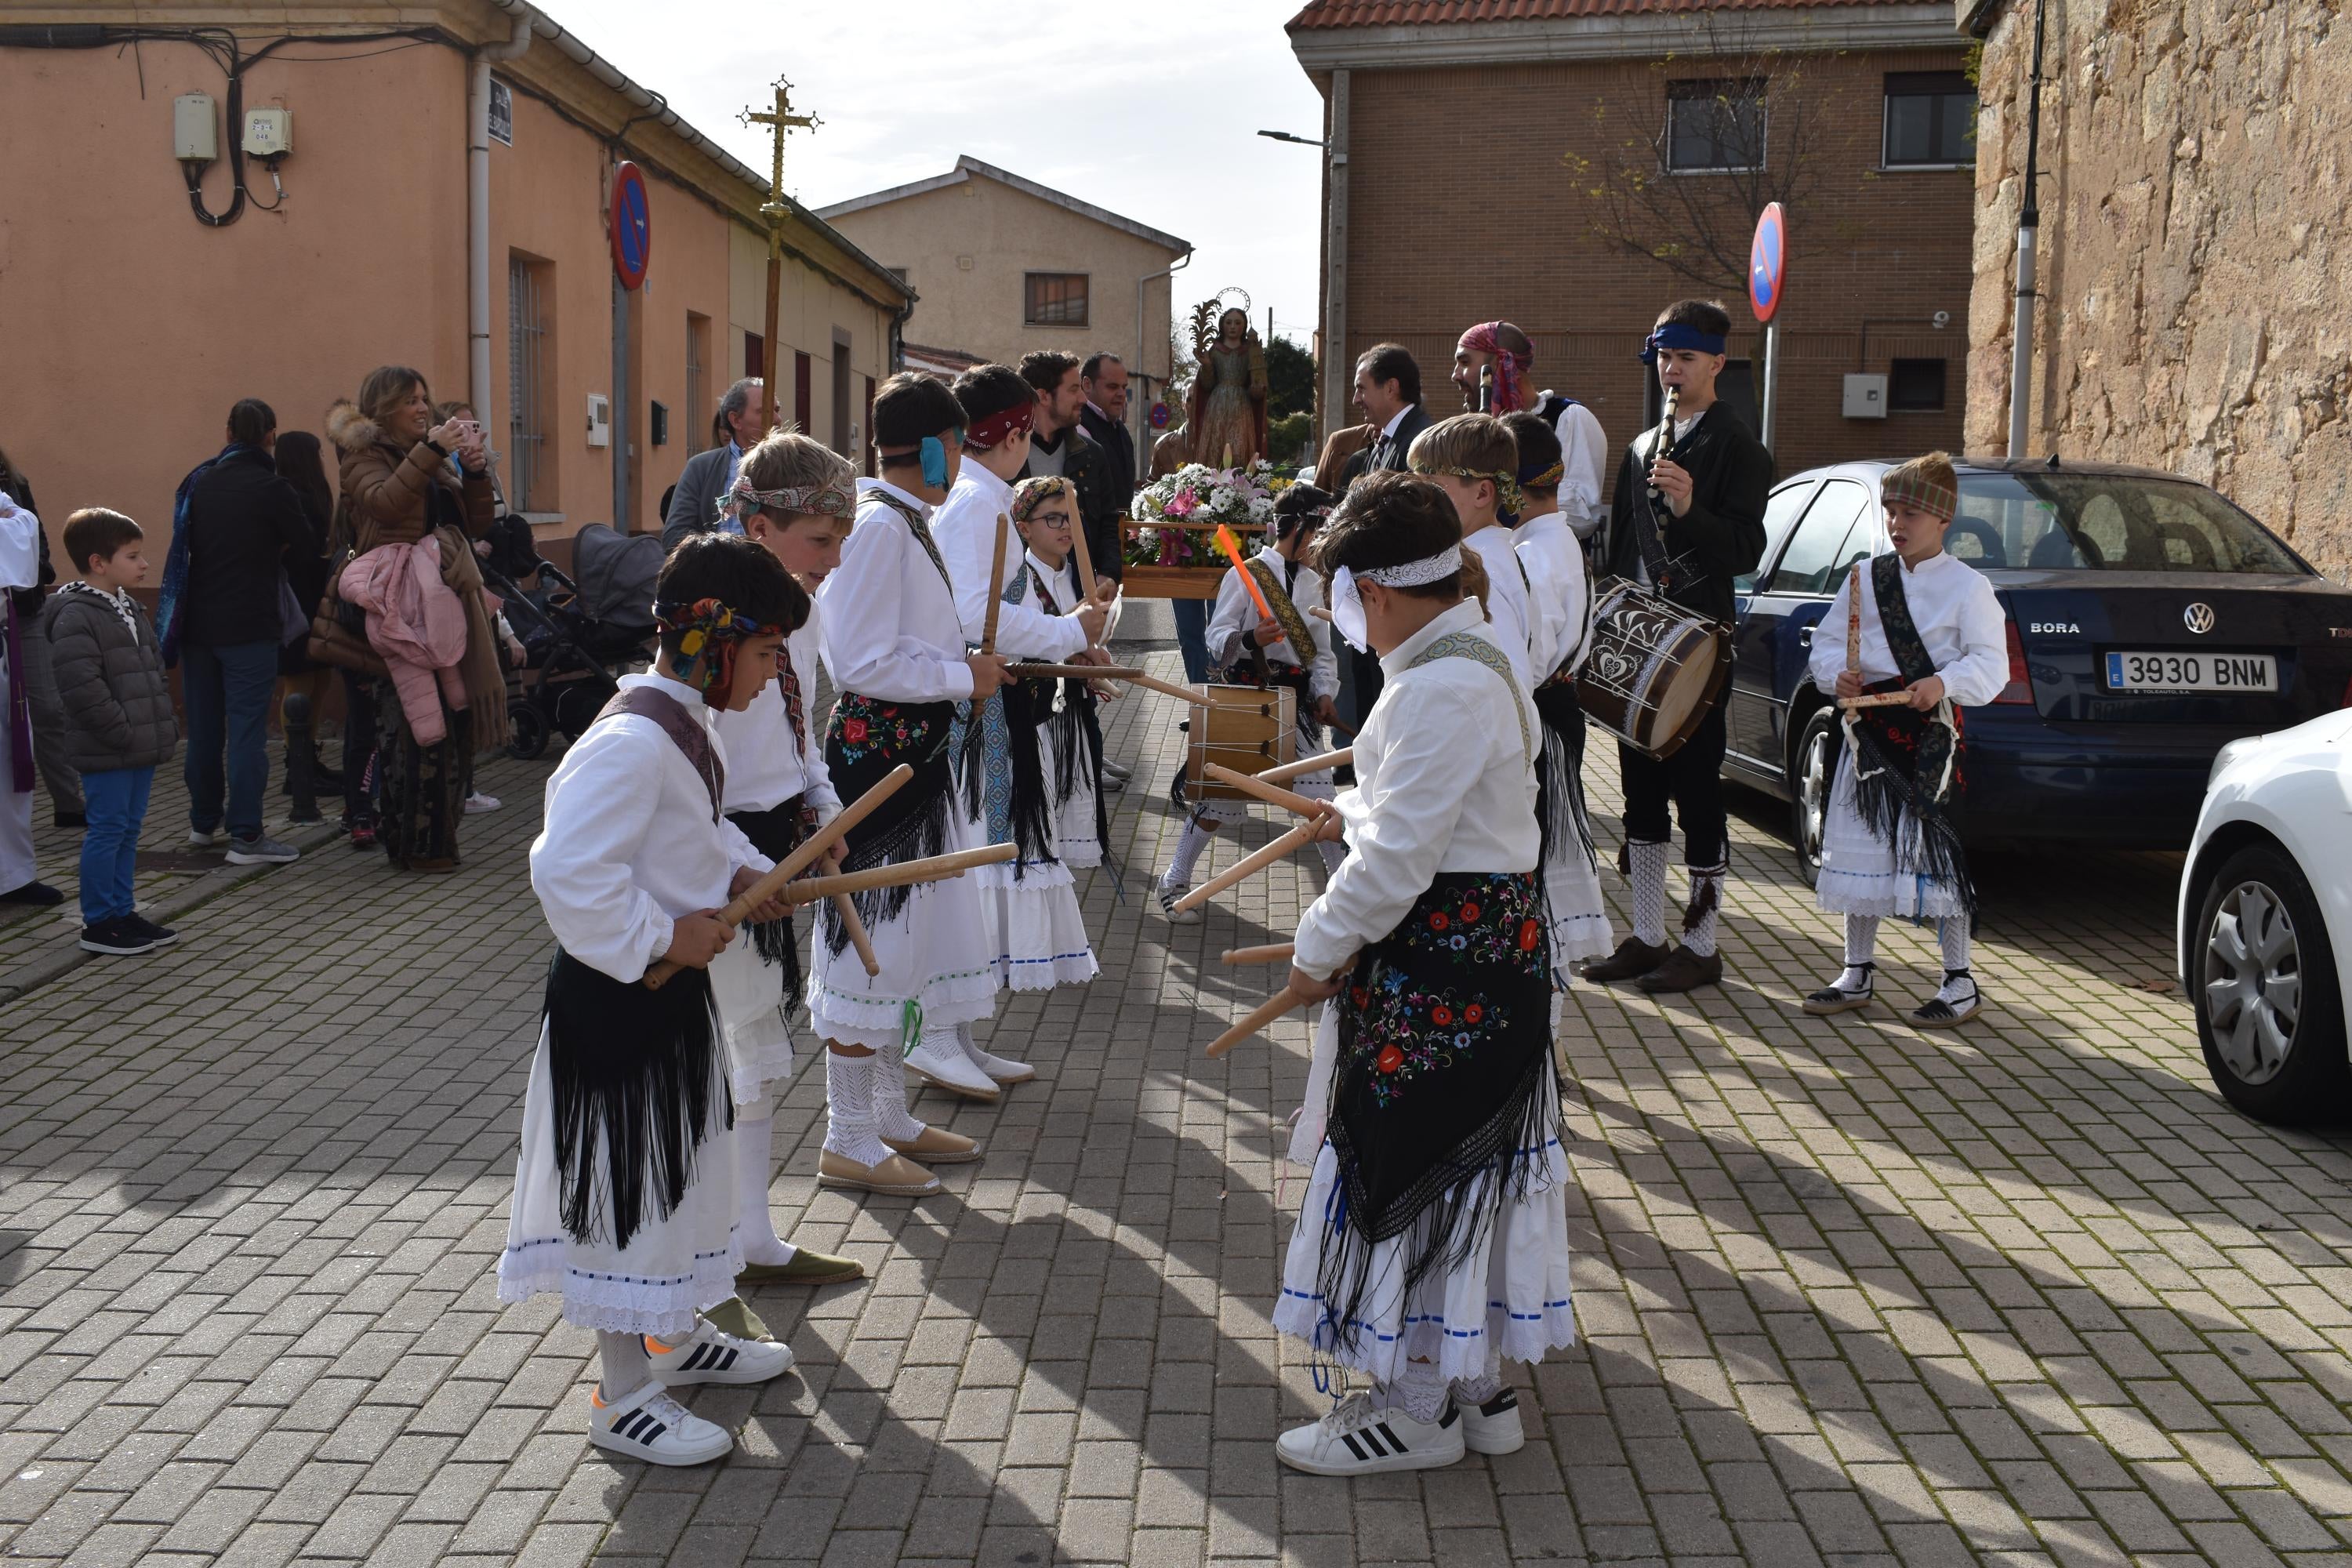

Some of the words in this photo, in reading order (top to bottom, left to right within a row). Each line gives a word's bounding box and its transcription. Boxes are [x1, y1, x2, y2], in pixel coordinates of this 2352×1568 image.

[2031, 622, 2080, 633] BORA
[2129, 656, 2201, 684] 3930
[2214, 658, 2267, 687] BNM
[2113, 673, 2120, 682] E
